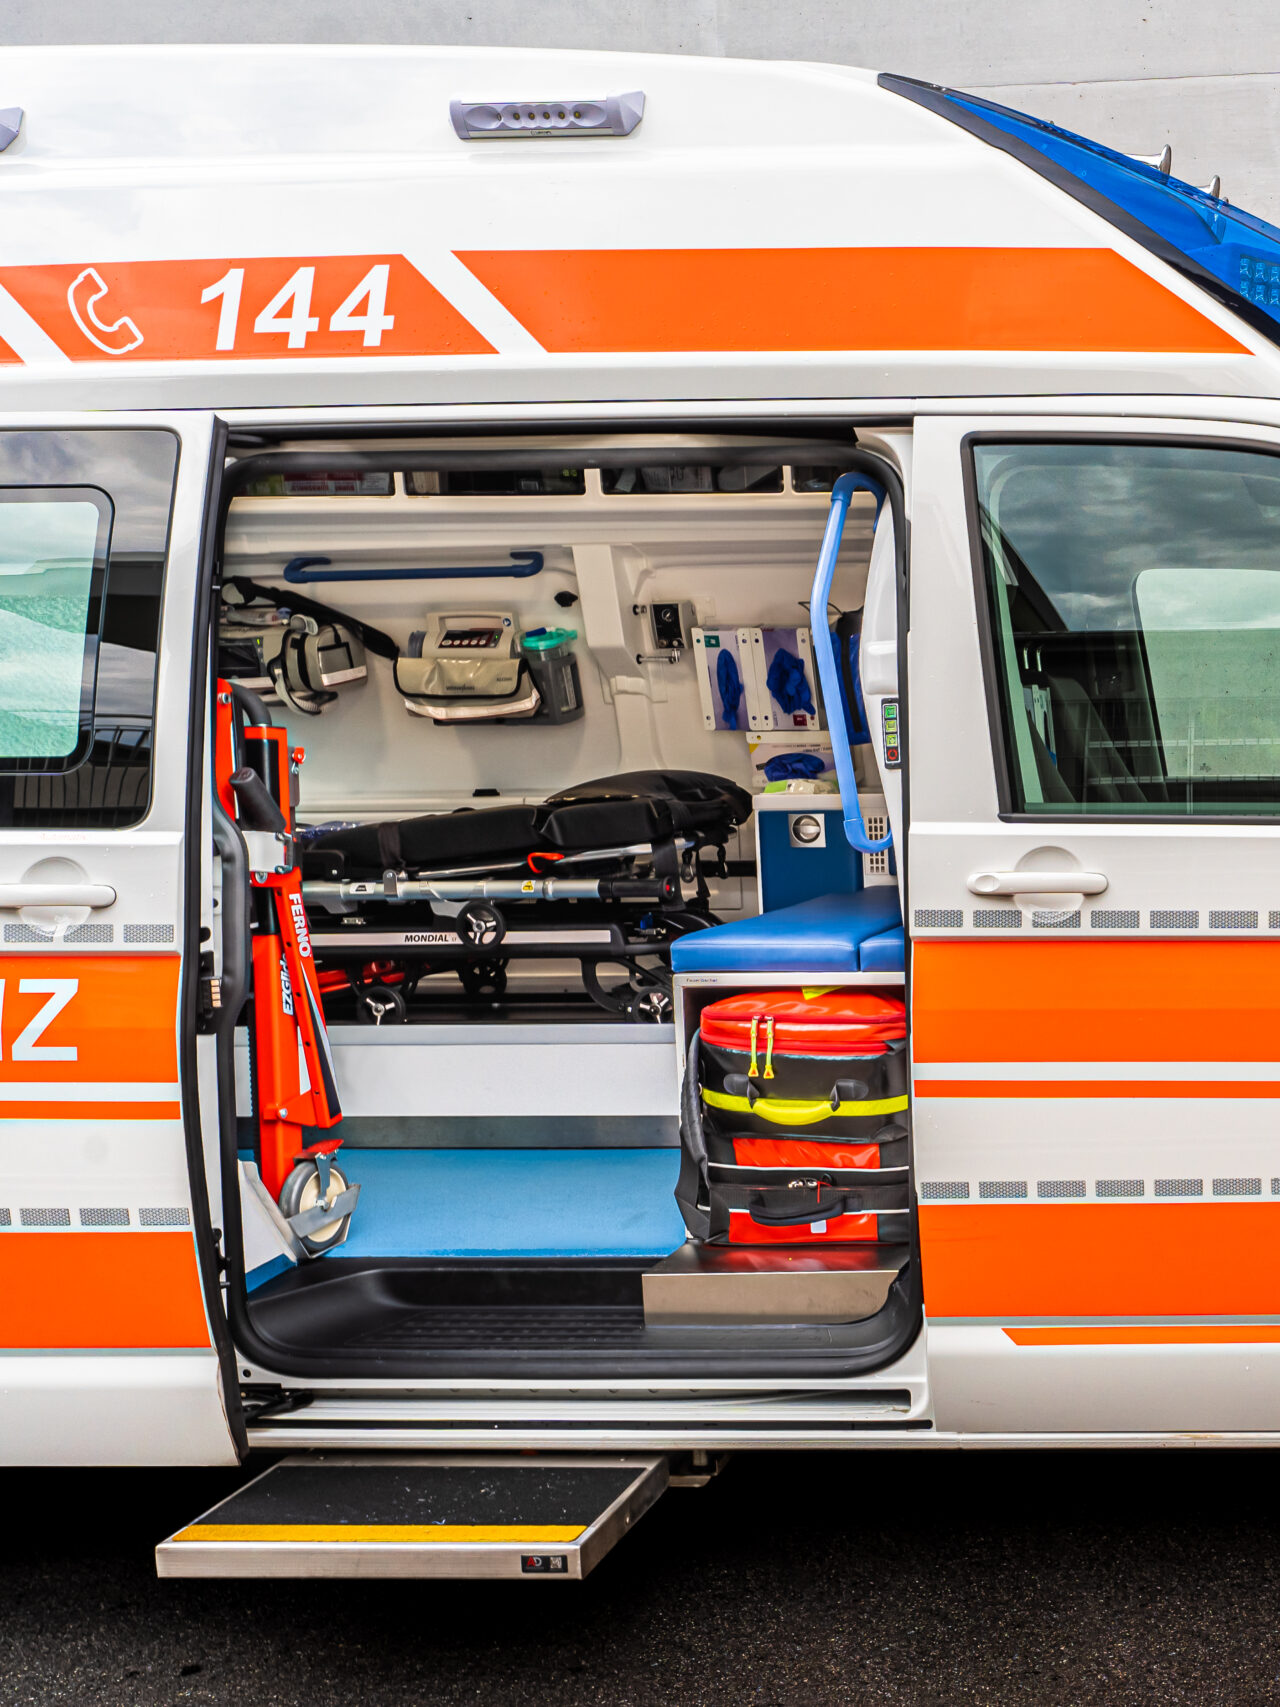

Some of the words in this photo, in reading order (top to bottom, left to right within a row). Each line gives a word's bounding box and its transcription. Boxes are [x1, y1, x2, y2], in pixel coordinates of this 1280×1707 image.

[201, 264, 395, 350] 144
[289, 893, 312, 958] FERNO
[404, 934, 449, 943] MONDIAL
[0, 978, 79, 1061] Z
